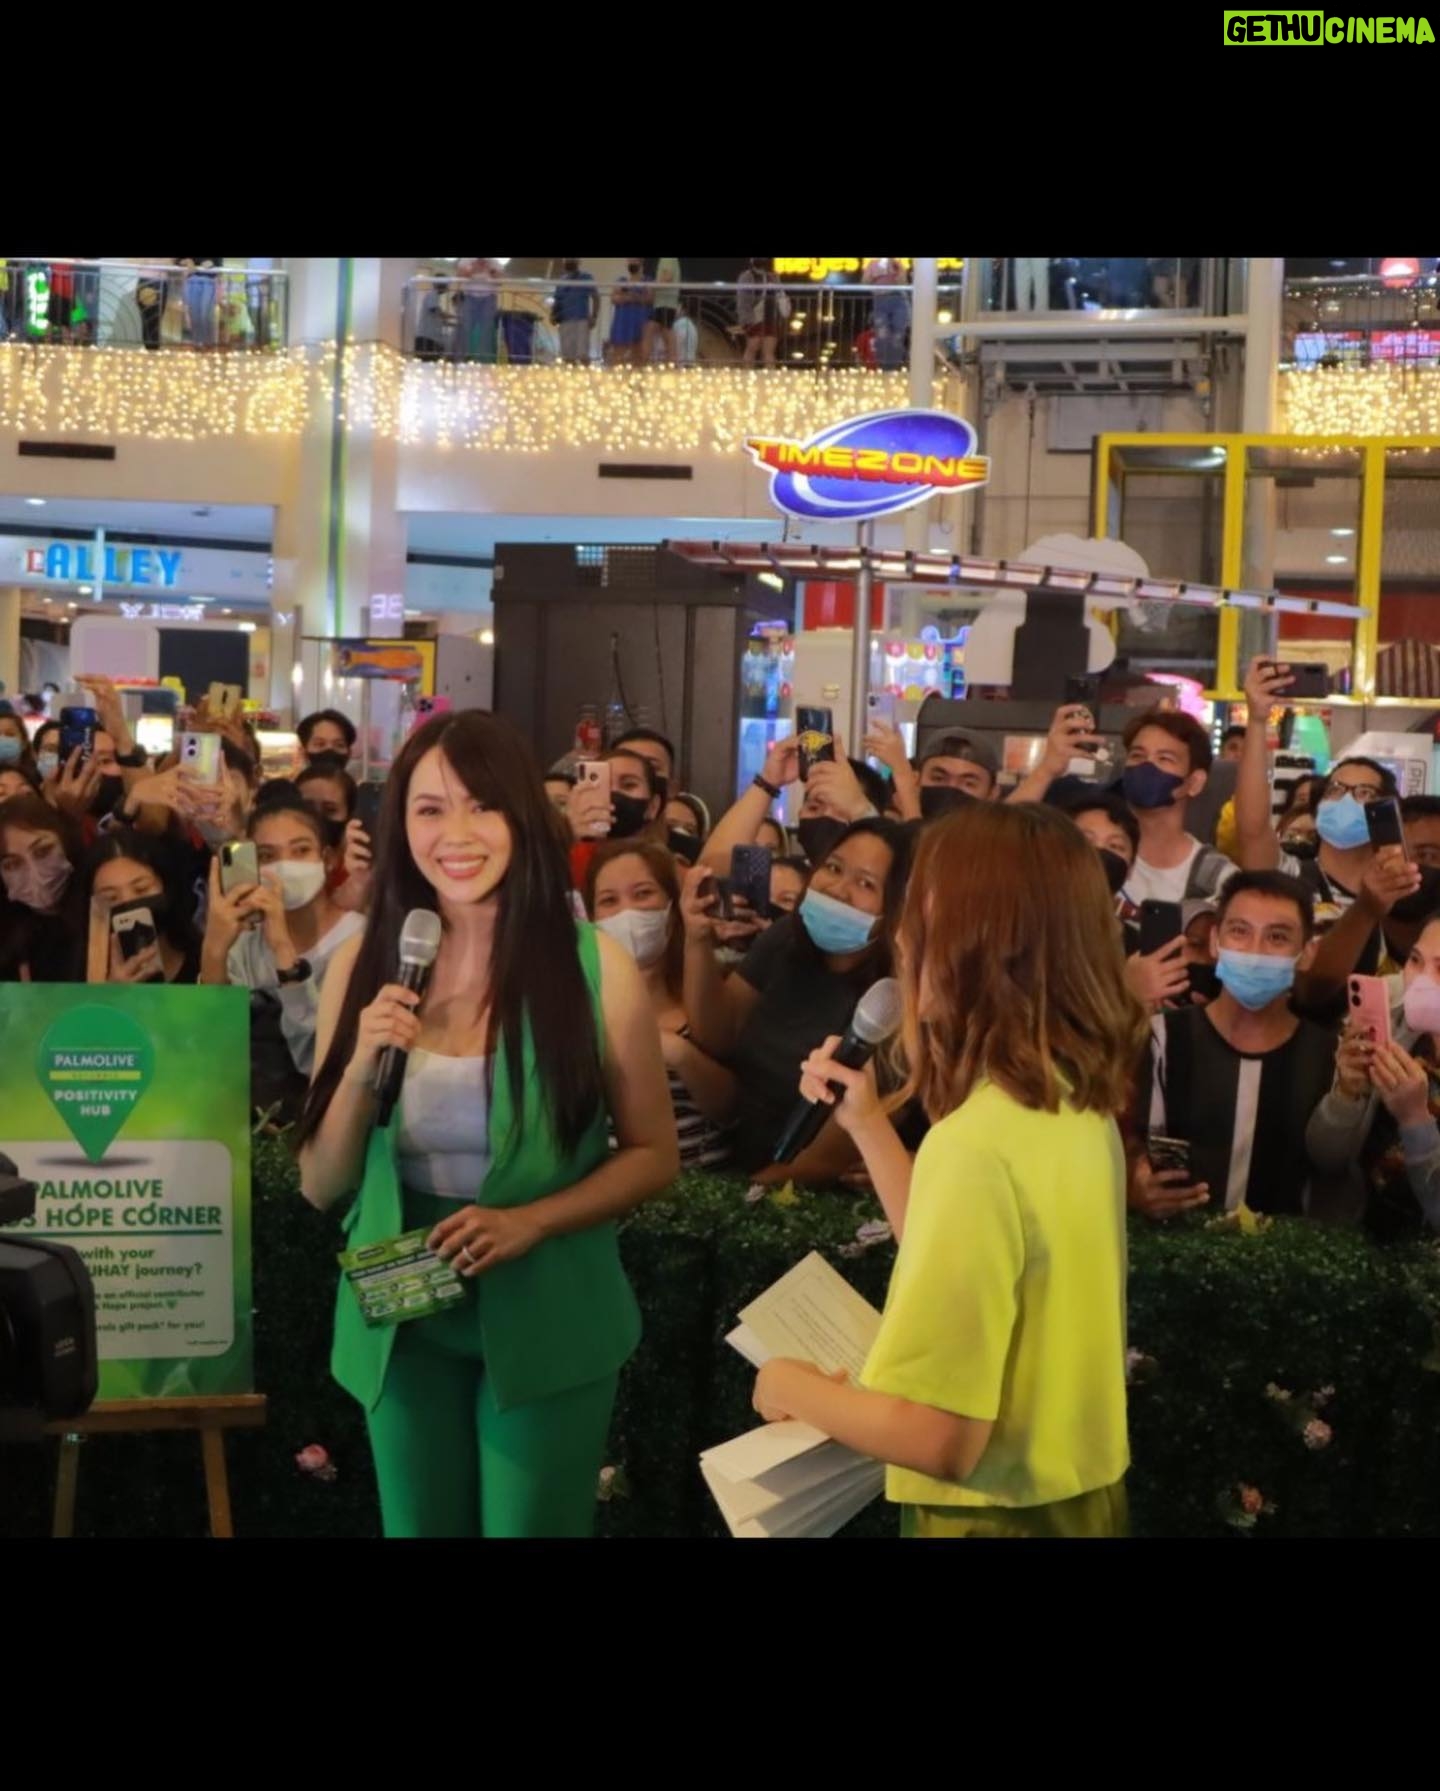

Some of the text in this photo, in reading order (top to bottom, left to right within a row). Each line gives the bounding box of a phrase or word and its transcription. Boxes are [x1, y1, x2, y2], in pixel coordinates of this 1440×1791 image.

[757, 441, 988, 479] TIMEZONE
[46, 542, 183, 586] ALLEY
[54, 1053, 135, 1067] PALMOLIVE
[54, 1089, 138, 1101] POSITIVITY
[80, 1104, 112, 1117] HUB
[81, 1246, 155, 1261] with your
[89, 1262, 203, 1279] UHAY journey?
